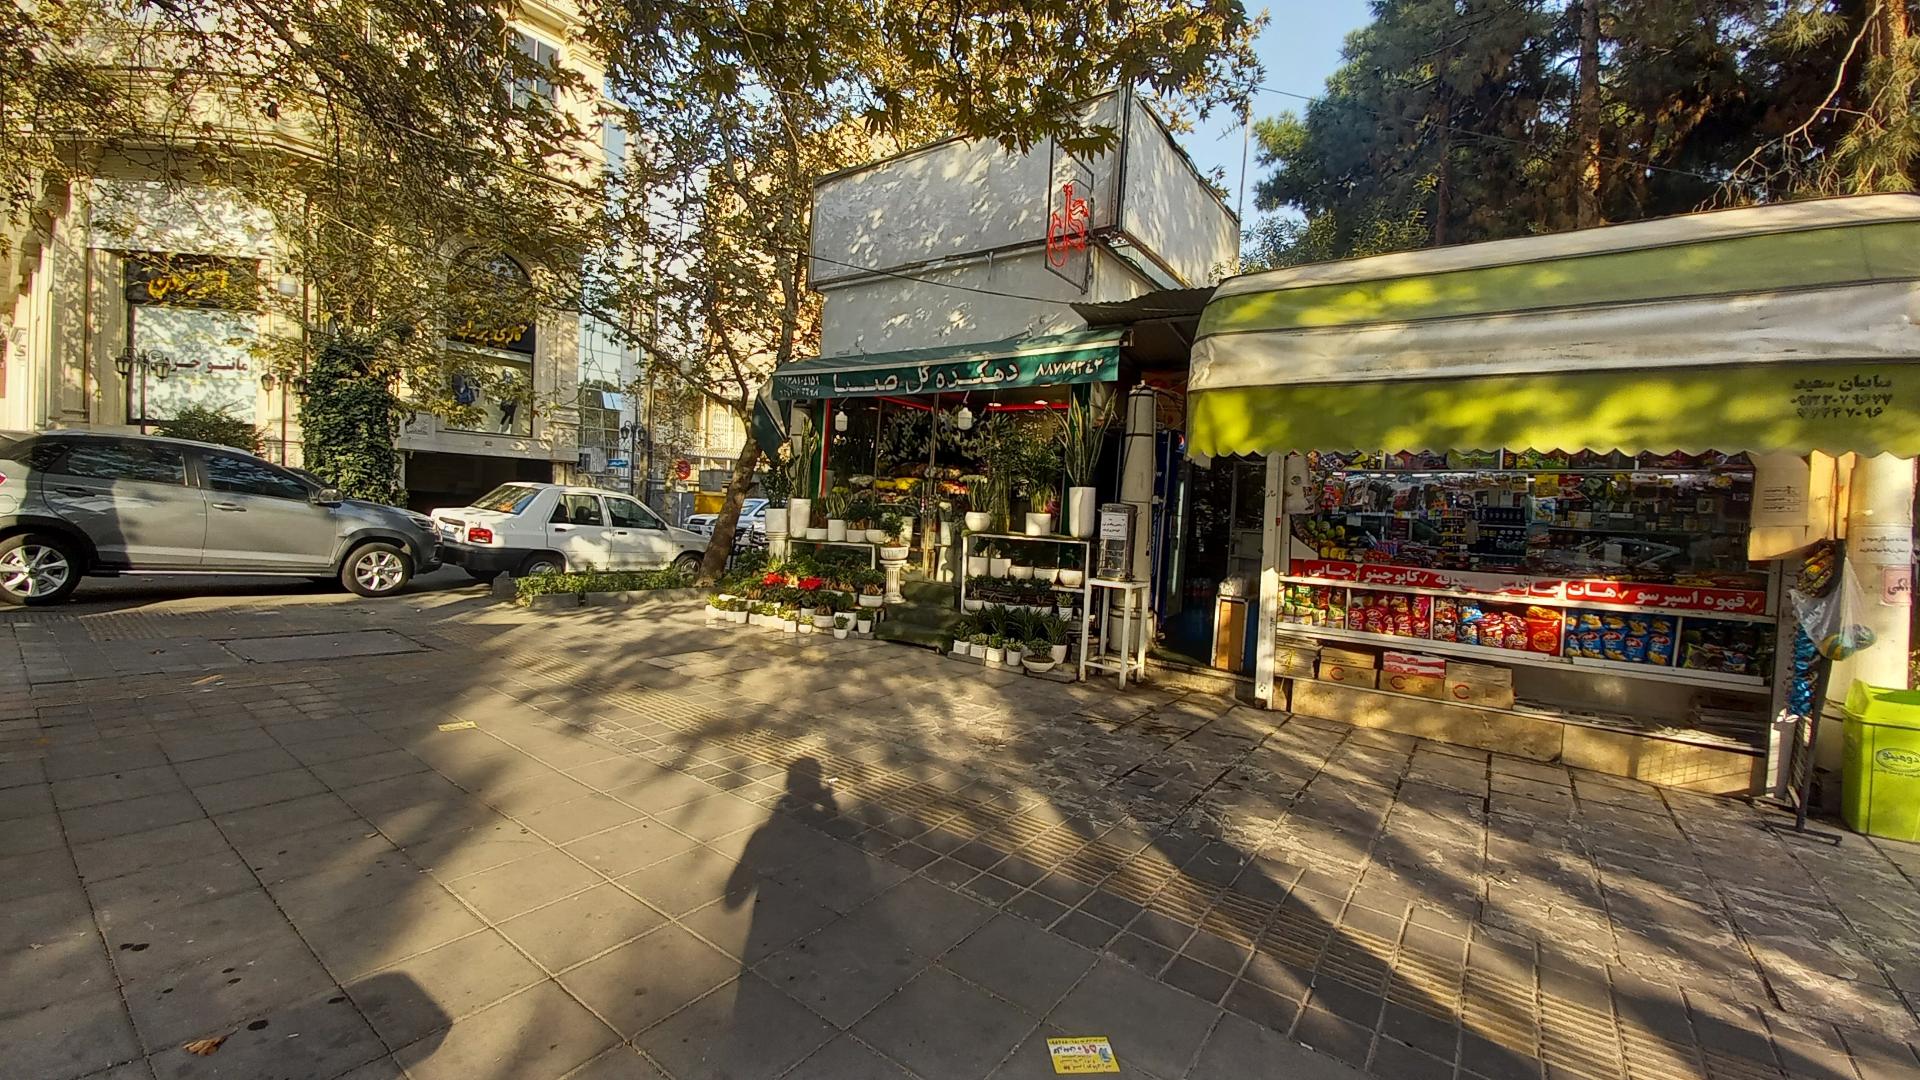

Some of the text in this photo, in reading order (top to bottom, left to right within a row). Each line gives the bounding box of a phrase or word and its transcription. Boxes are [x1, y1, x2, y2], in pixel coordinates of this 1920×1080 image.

[906, 366, 931, 394] گل
[936, 360, 1019, 389] دهکده
[1363, 569, 1420, 586] کاپوچینو
[1568, 582, 1617, 600] هات
[1702, 594, 1747, 611] قهوه
